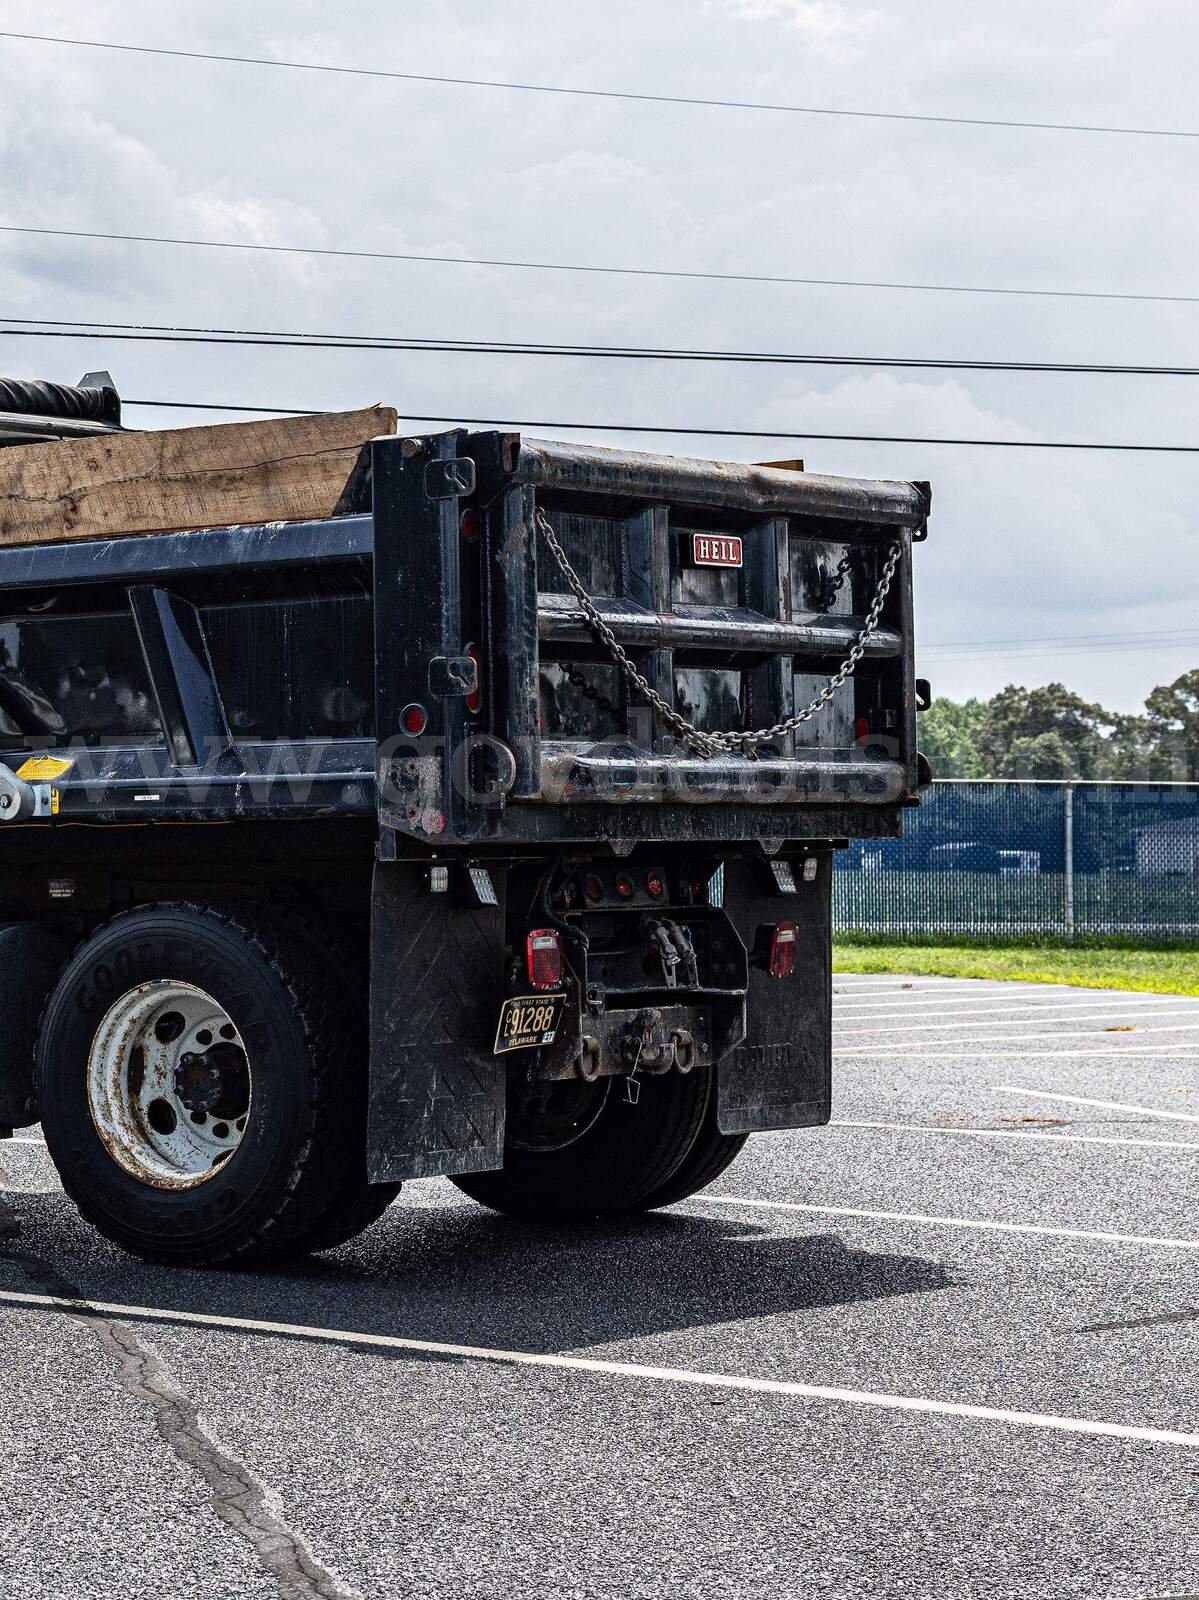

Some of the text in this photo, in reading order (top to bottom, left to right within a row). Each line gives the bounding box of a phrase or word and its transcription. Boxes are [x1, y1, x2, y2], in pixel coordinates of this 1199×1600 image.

[700, 540, 737, 561] HEIL
[510, 1005, 555, 1035] 91288
[508, 1036, 538, 1047] DELAWARE
